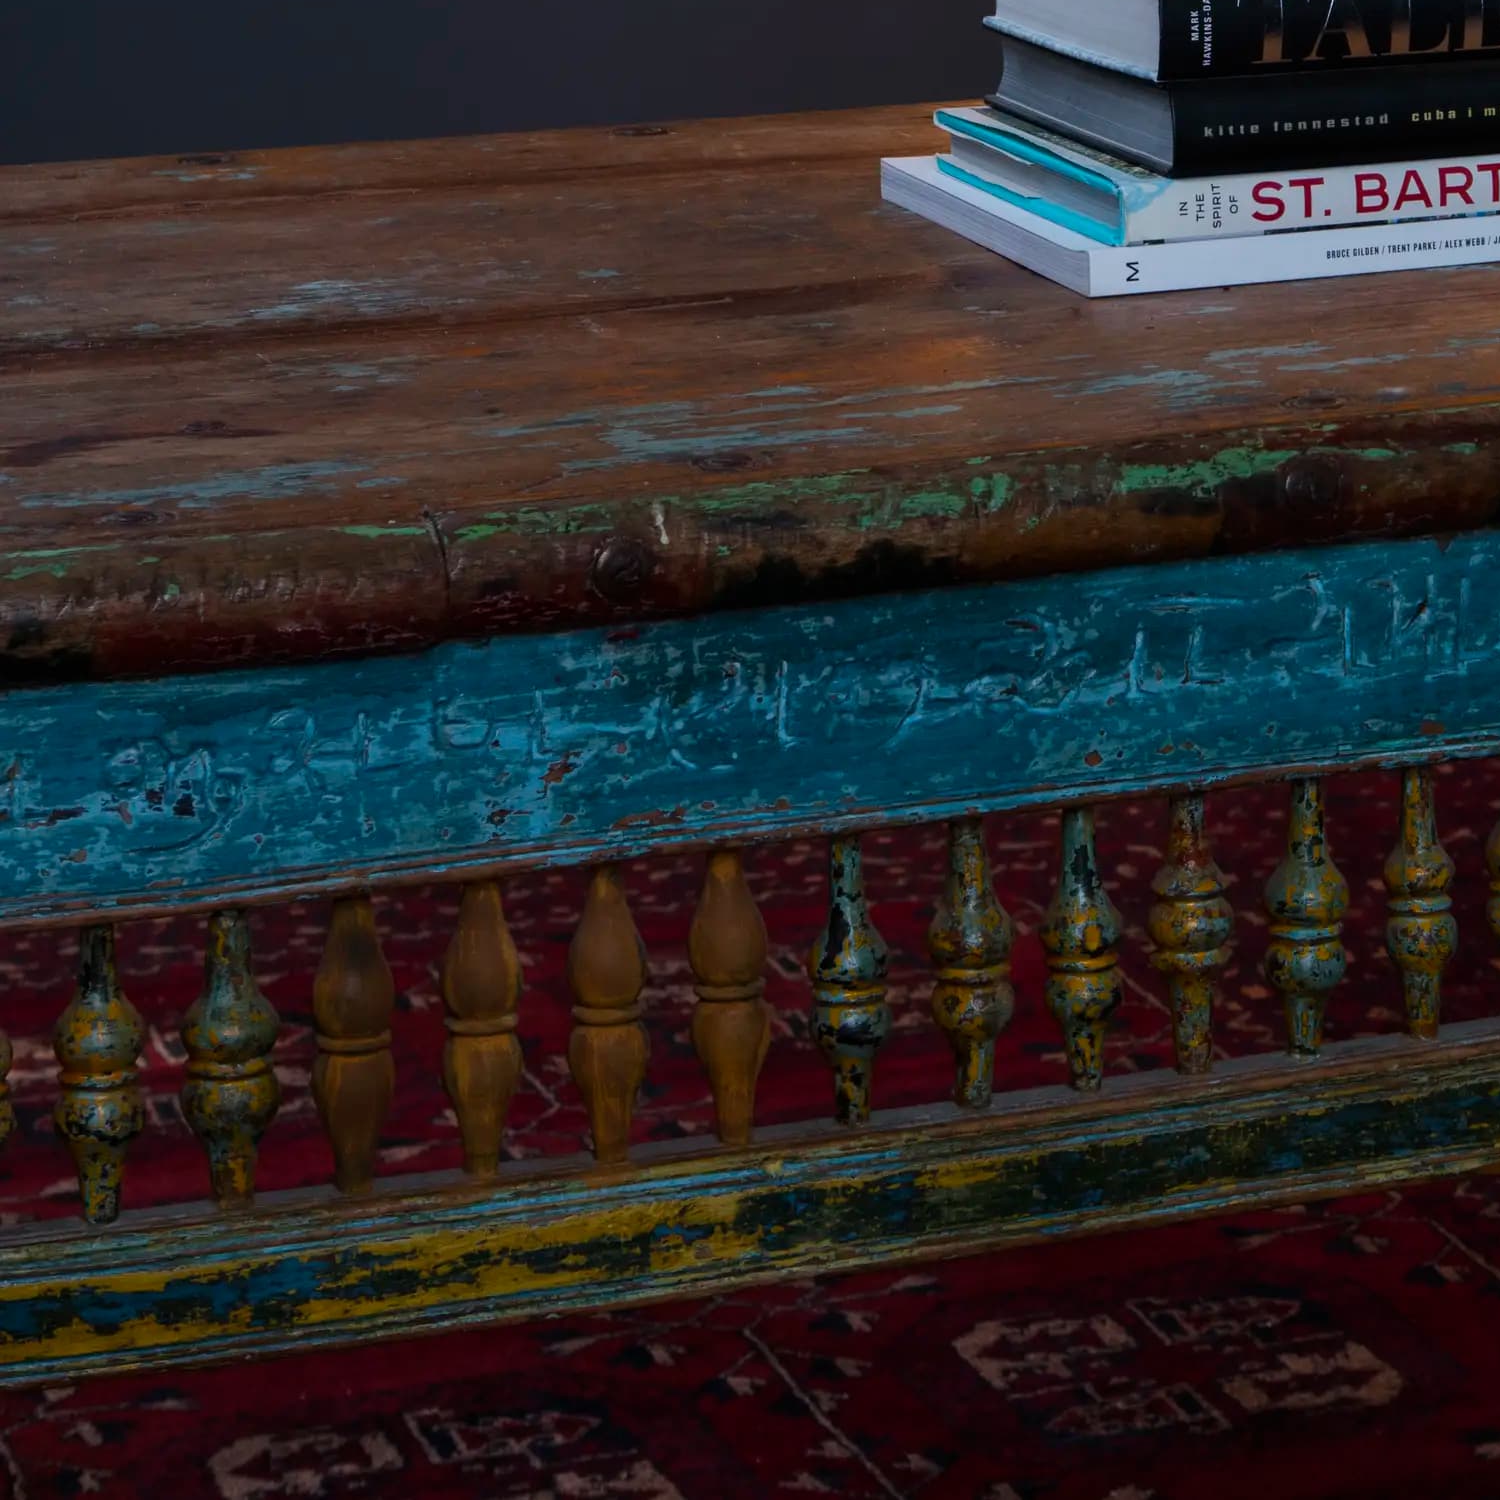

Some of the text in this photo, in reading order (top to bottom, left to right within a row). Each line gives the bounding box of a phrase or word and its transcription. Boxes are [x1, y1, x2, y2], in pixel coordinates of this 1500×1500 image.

[1190, 9, 1199, 41] MARK
[1203, 112, 1389, 138] kitte fennestad
[1410, 108, 1457, 122] cuba
[1467, 106, 1473, 118] i
[1179, 201, 1189, 216] IN
[1195, 193, 1205, 222] THE
[1210, 183, 1222, 229] SPIRIT
[1229, 195, 1239, 214] OF
[1251, 177, 1332, 222] ST.
[1326, 249, 1350, 259] BRUCE
[1352, 246, 1379, 257] GILDEN
[1387, 244, 1410, 254] TRENT
[1413, 241, 1437, 251] PARKE
[1445, 239, 1462, 249] ALEX
[1465, 237, 1485, 246] WEBB
